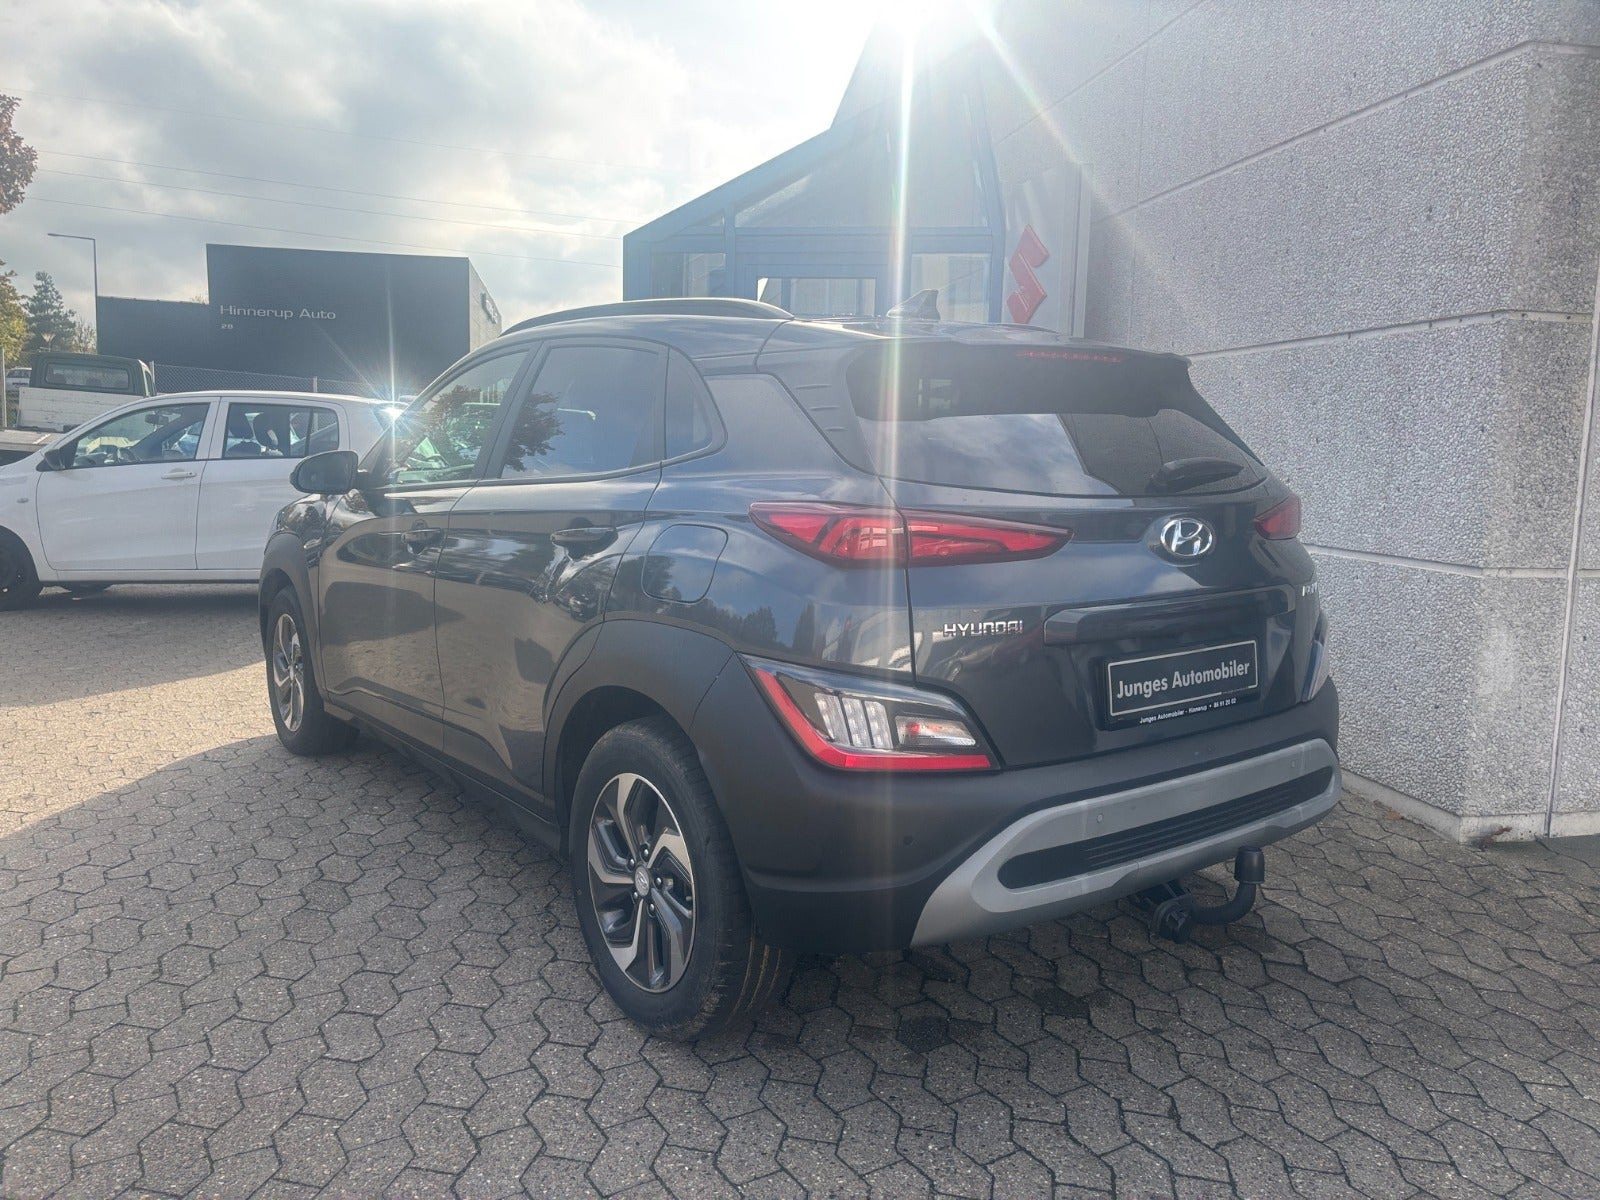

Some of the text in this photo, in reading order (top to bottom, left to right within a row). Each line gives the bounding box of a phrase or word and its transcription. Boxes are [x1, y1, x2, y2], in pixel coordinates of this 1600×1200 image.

[220, 305, 336, 319] Hinnerup Auto
[944, 620, 1023, 636] HYUNDAI
[1117, 660, 1250, 698] Junges Automobiler
[1140, 716, 1157, 724] Junges
[1157, 709, 1185, 720] Automobiler
